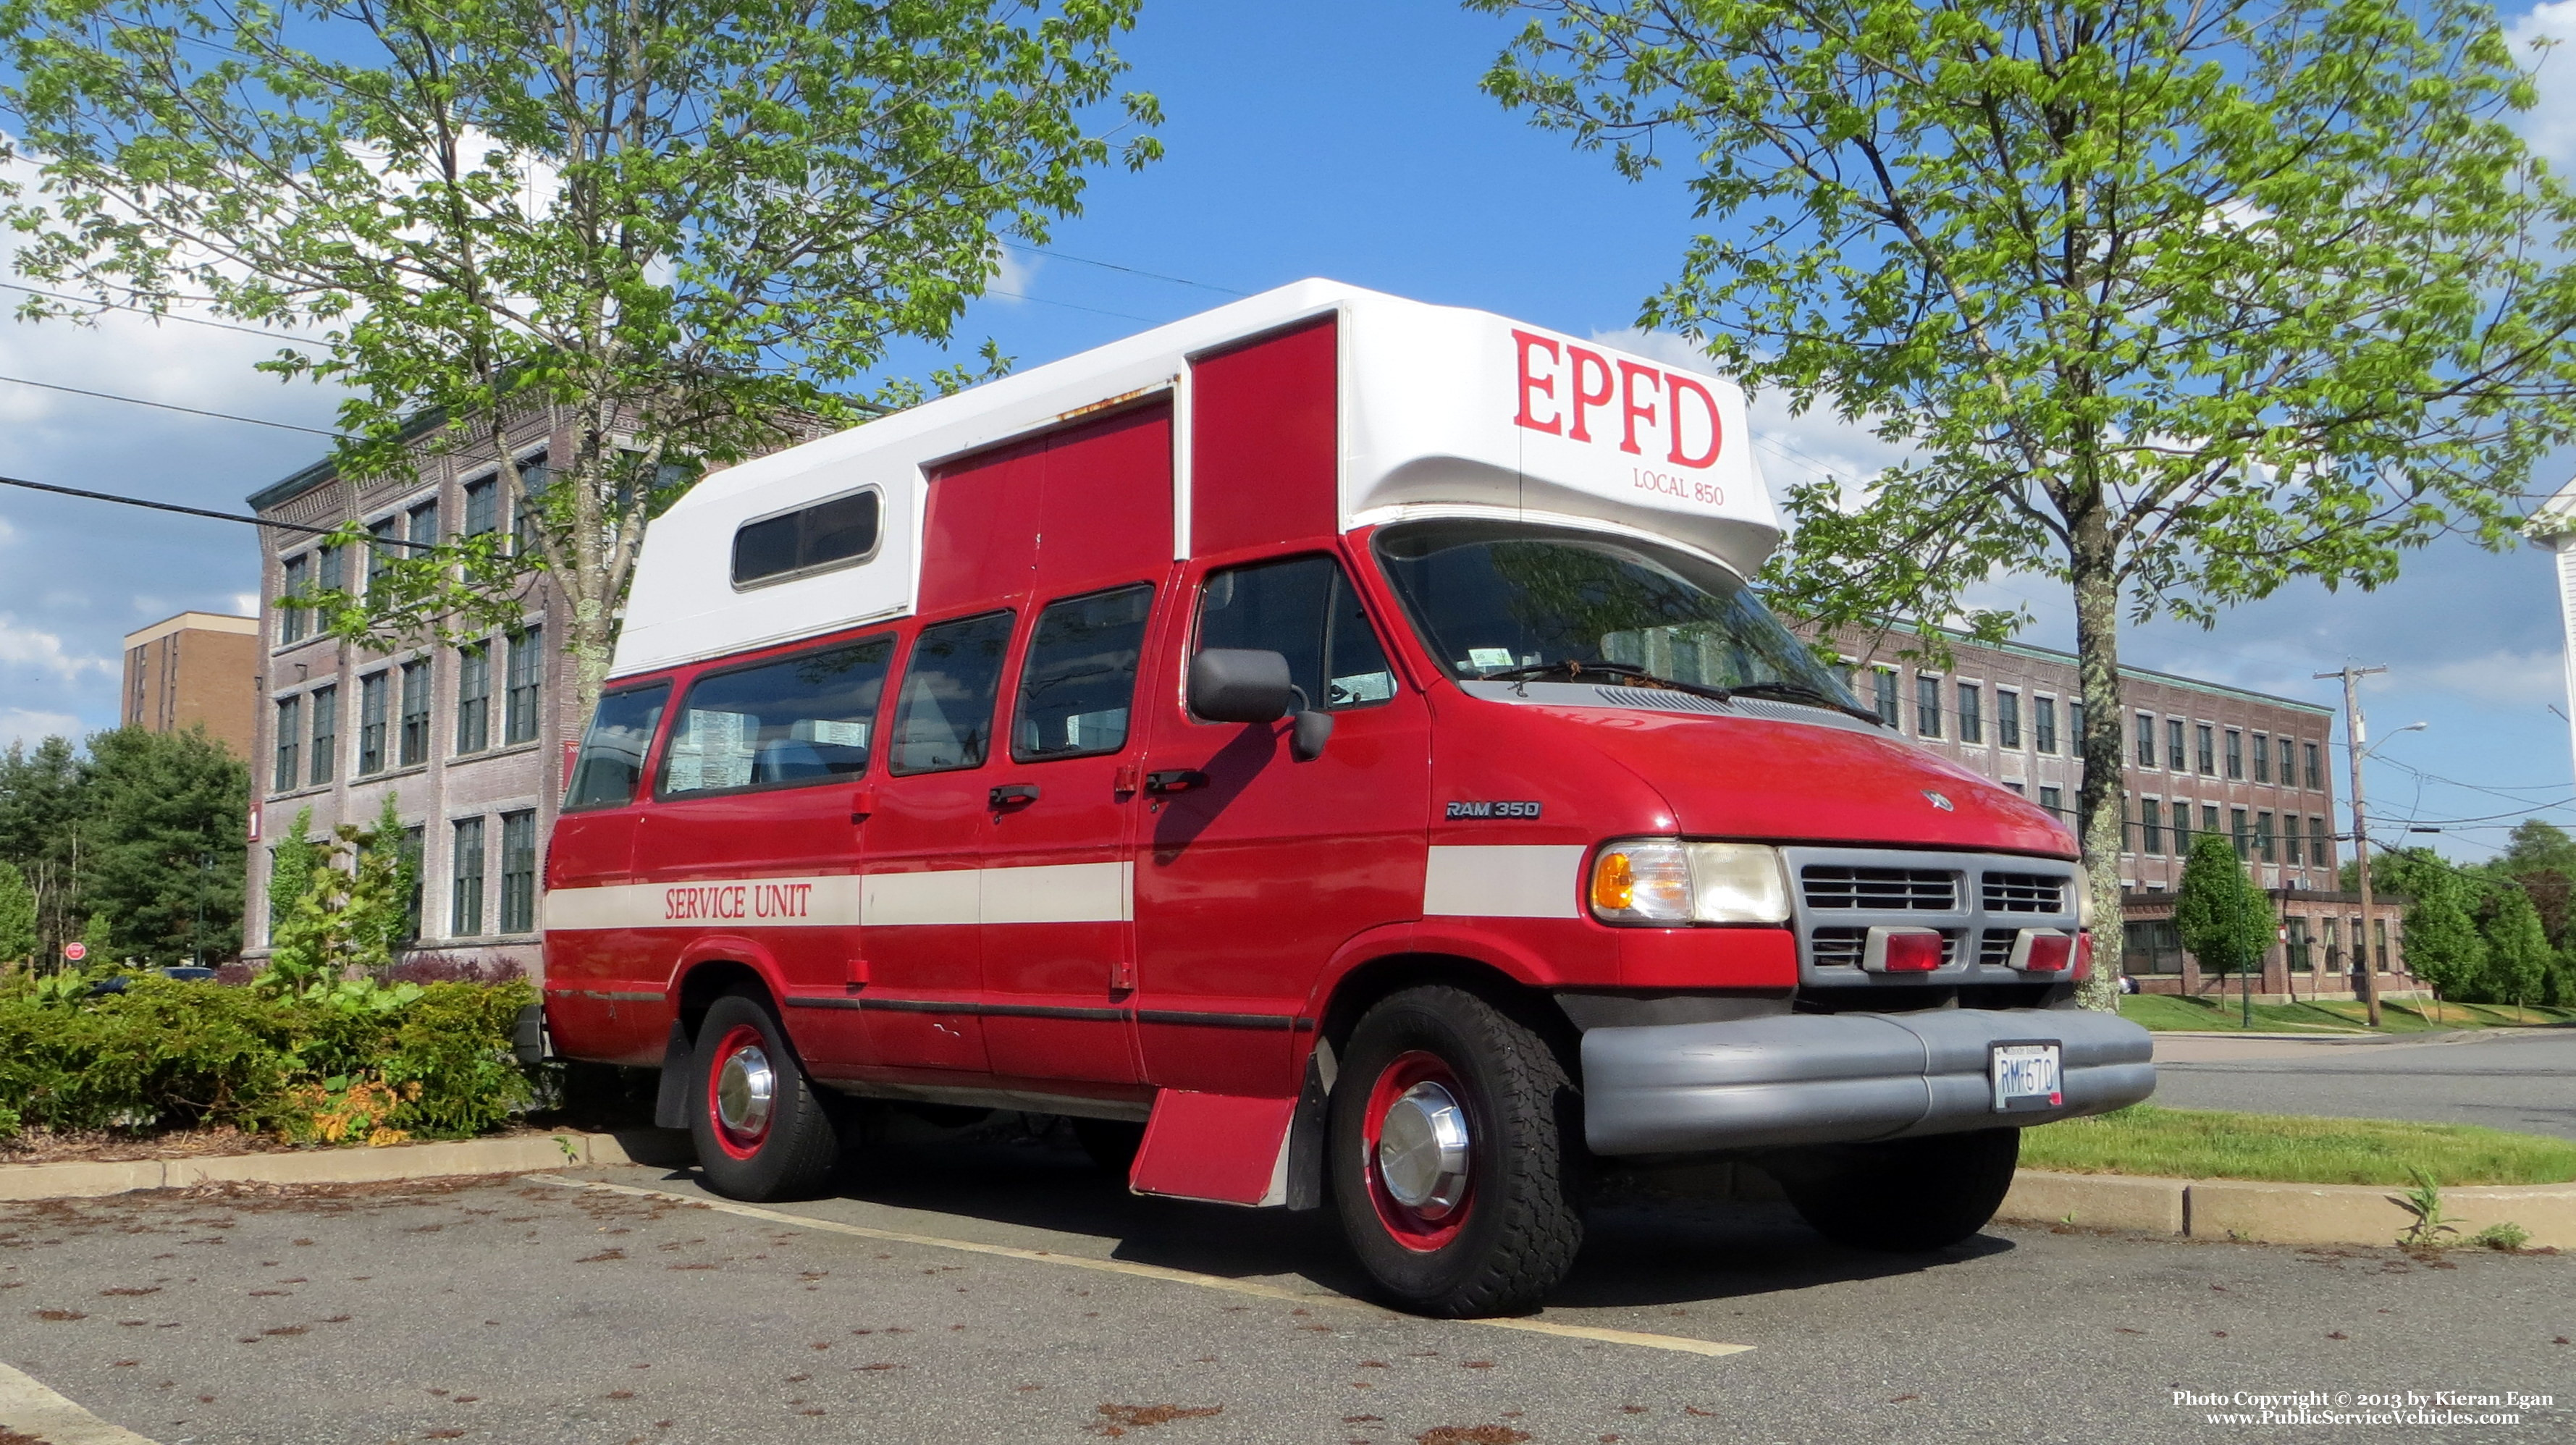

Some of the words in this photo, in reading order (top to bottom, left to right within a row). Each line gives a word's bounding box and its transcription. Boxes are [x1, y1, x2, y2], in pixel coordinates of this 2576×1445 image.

[1510, 328, 1723, 469] EPFD
[1633, 467, 1689, 498] LOCAL
[1694, 481, 1724, 506] 850
[1447, 801, 1491, 817] RAM
[1495, 801, 1540, 817] 350
[665, 885, 746, 919] SERVICE
[754, 883, 812, 918] UNIT
